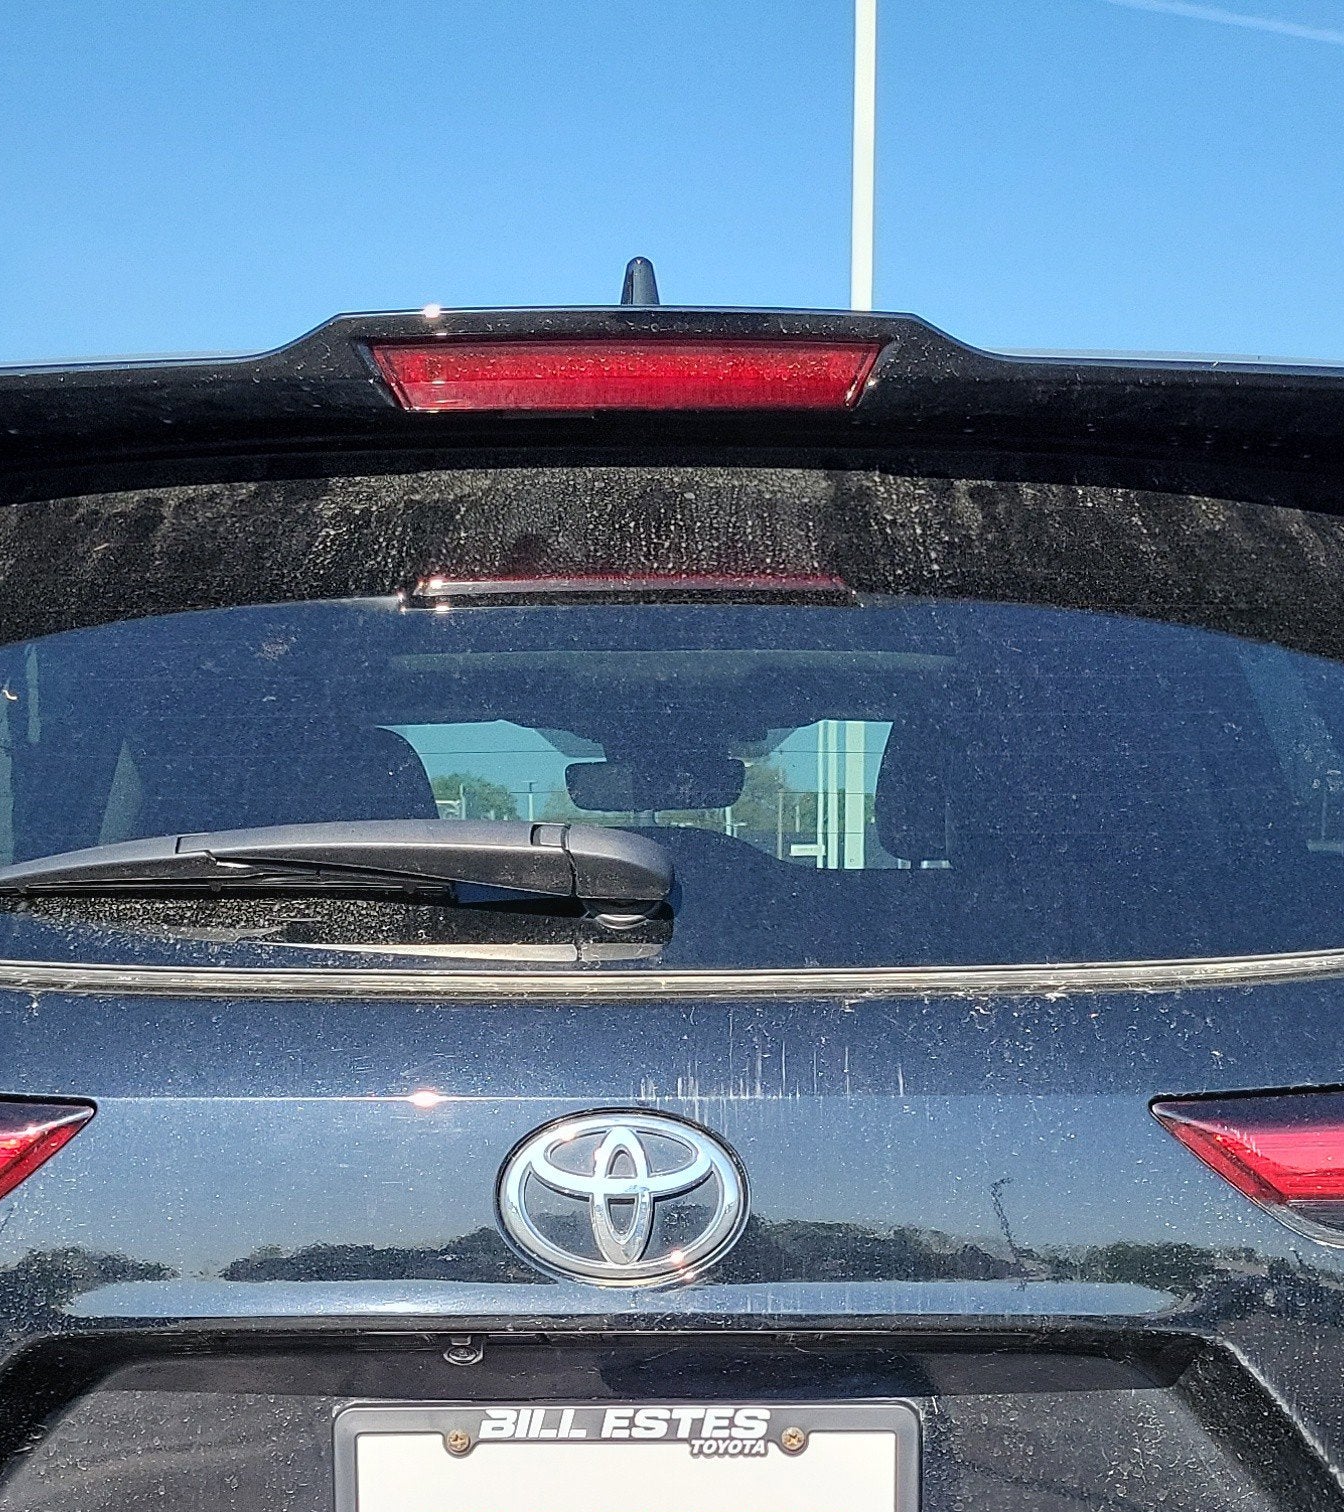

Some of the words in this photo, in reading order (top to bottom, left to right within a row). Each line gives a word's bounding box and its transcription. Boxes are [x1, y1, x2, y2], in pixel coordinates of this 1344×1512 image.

[478, 1409, 587, 1440] BILL
[601, 1408, 771, 1439] ESTES
[690, 1439, 767, 1456] TOYOTA
